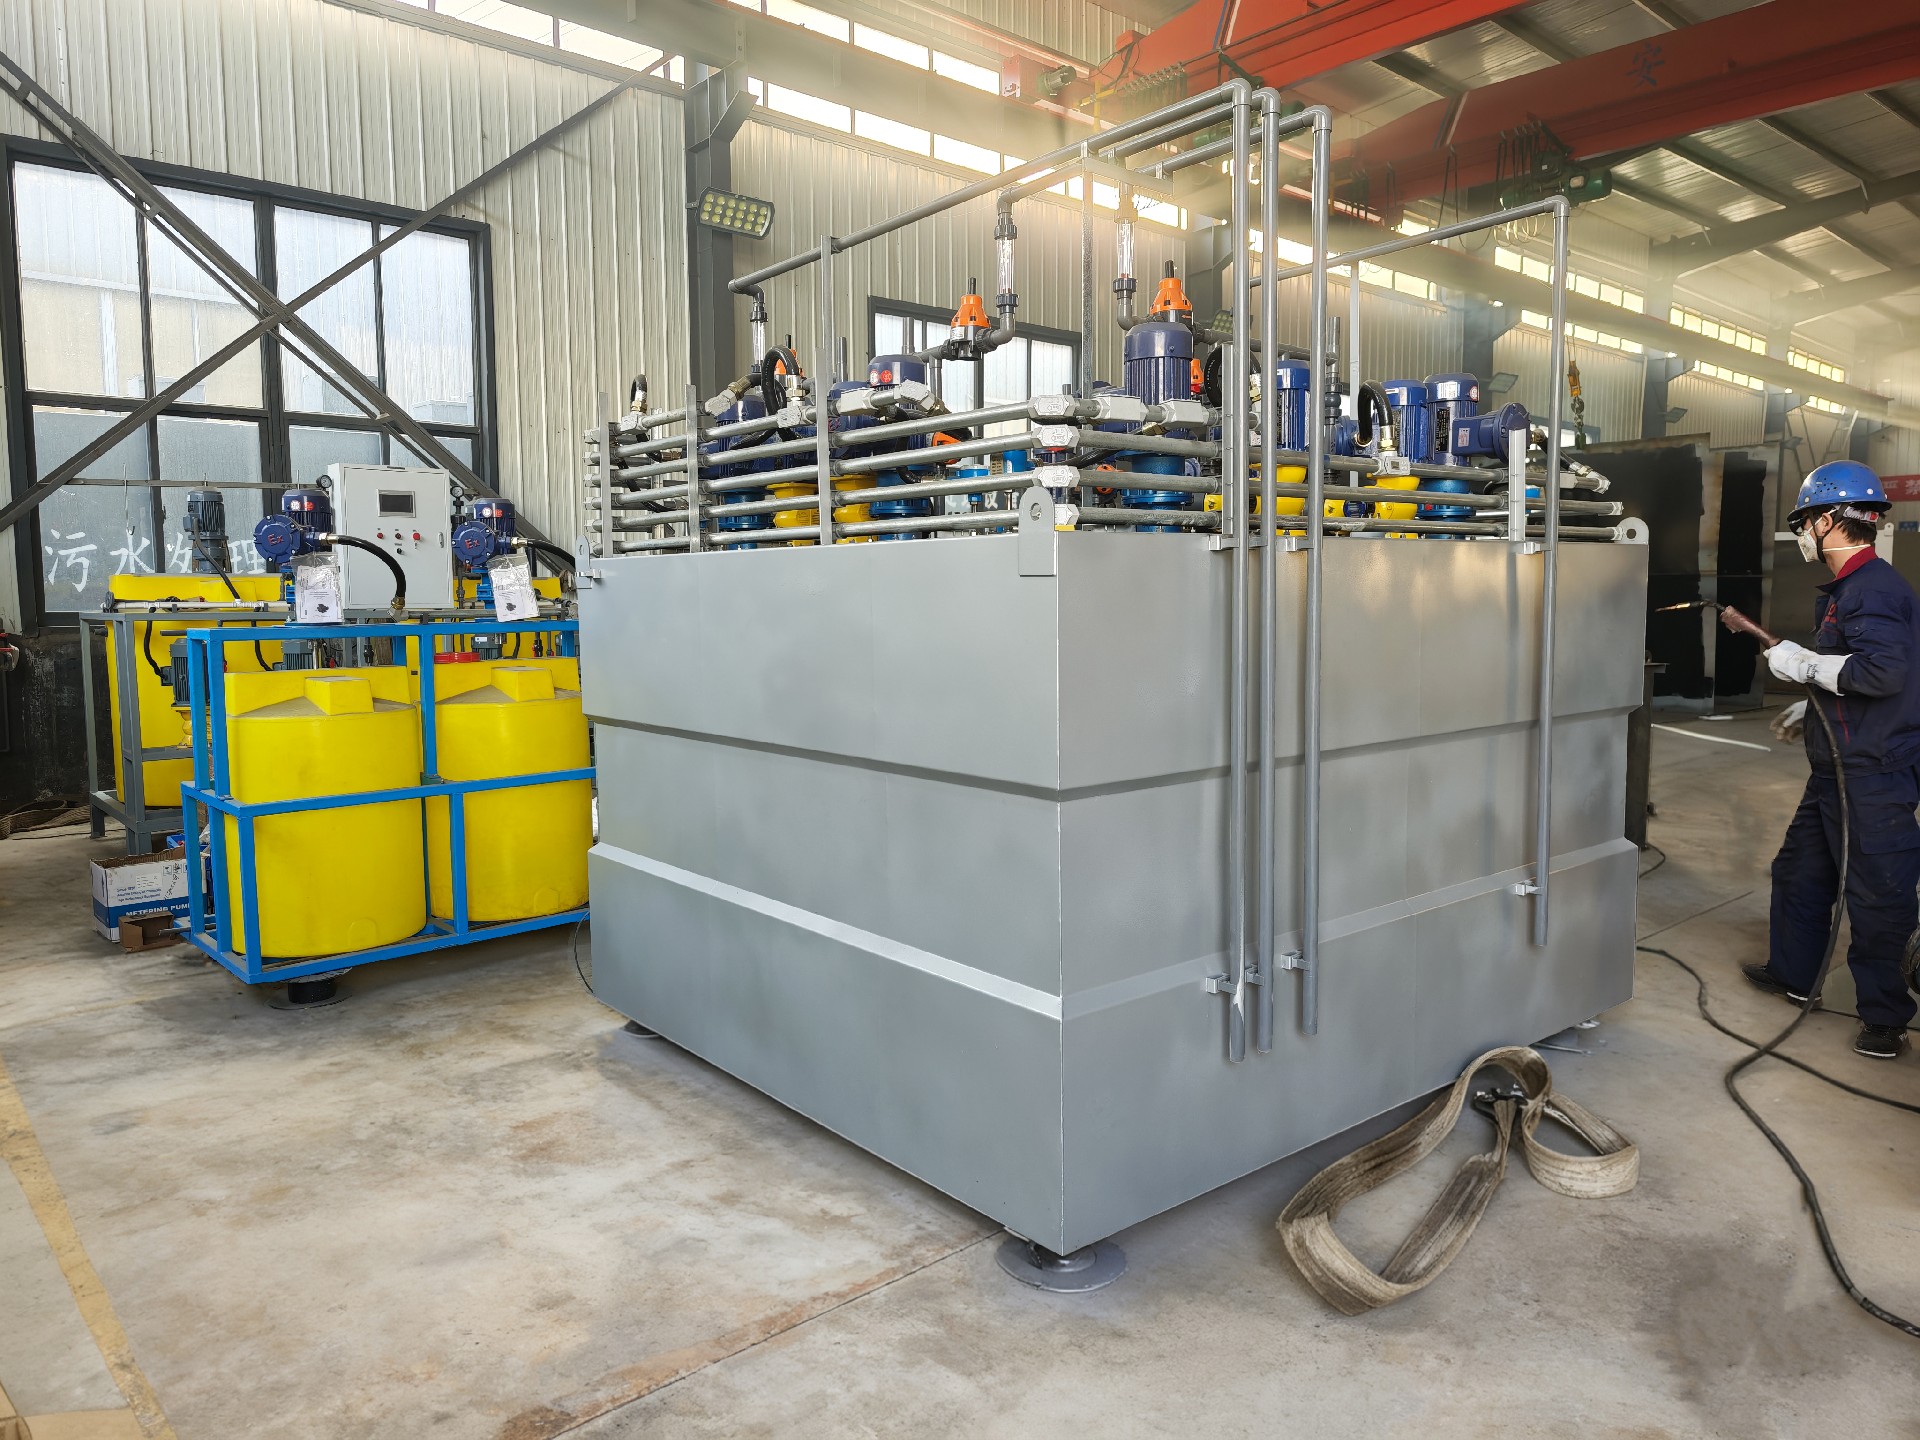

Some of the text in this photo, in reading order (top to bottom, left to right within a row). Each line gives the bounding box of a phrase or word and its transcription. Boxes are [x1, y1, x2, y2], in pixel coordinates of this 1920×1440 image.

[1624, 42, 1665, 88] 安
[267, 533, 284, 546] Ex
[465, 538, 480, 549] Ex
[170, 902, 190, 911] PUM
